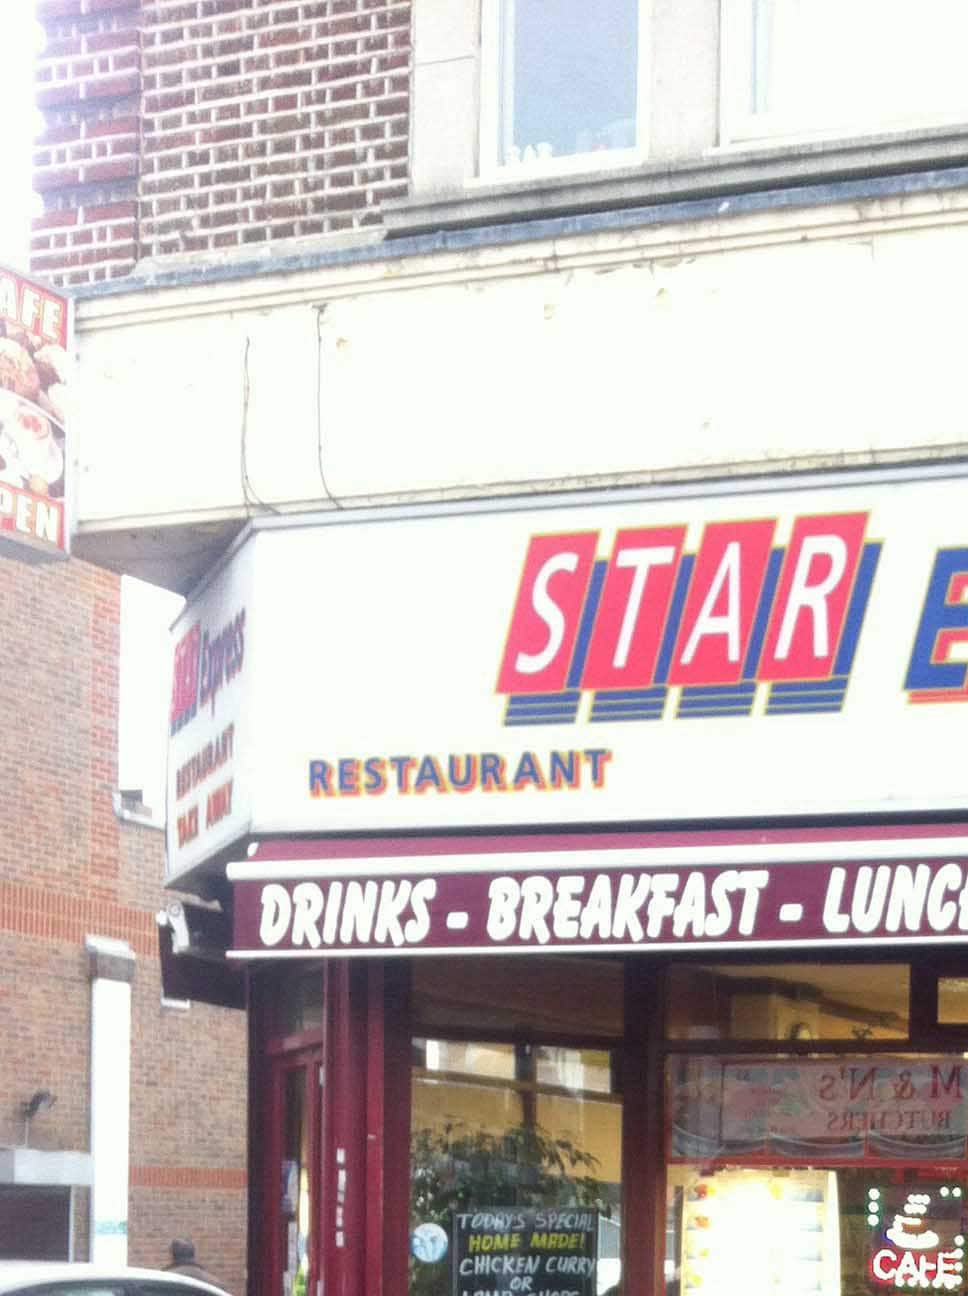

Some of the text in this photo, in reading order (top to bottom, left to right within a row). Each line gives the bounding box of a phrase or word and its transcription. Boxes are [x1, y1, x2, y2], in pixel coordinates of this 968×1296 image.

[0, 275, 61, 340] AFE
[0, 487, 59, 543] PEN
[512, 532, 849, 676] STAR
[308, 749, 613, 798] RESTAURANT
[258, 878, 437, 949] DRINKS
[486, 870, 769, 945] BREAKFAST
[468, 1233, 521, 1252] HOME
[535, 1213, 595, 1230] SPECIAL
[459, 1255, 595, 1277] CHICKEN CURRY
[509, 1276, 533, 1291] OR
